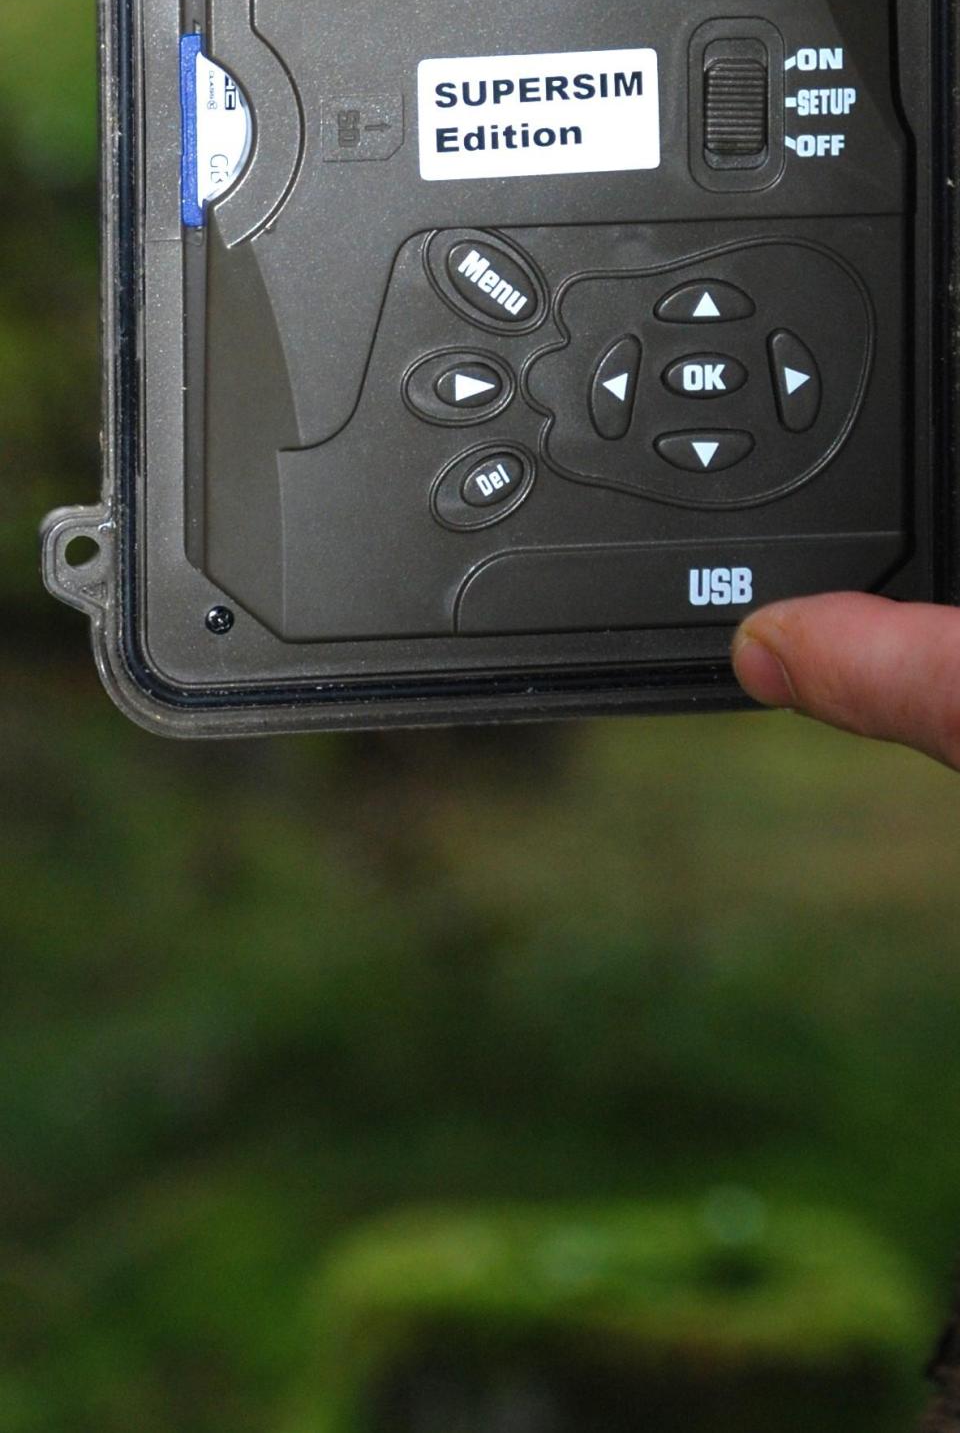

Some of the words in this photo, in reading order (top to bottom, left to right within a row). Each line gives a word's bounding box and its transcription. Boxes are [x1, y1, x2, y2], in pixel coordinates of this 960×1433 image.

[797, 48, 843, 71] ON
[435, 71, 643, 108] SUPERSIM
[797, 88, 856, 116] SETUP
[436, 123, 582, 153] Edition
[796, 134, 845, 157] OFF
[457, 250, 528, 315] Menu
[683, 364, 726, 391] OK
[475, 463, 510, 497] Del
[689, 567, 753, 606] USB
